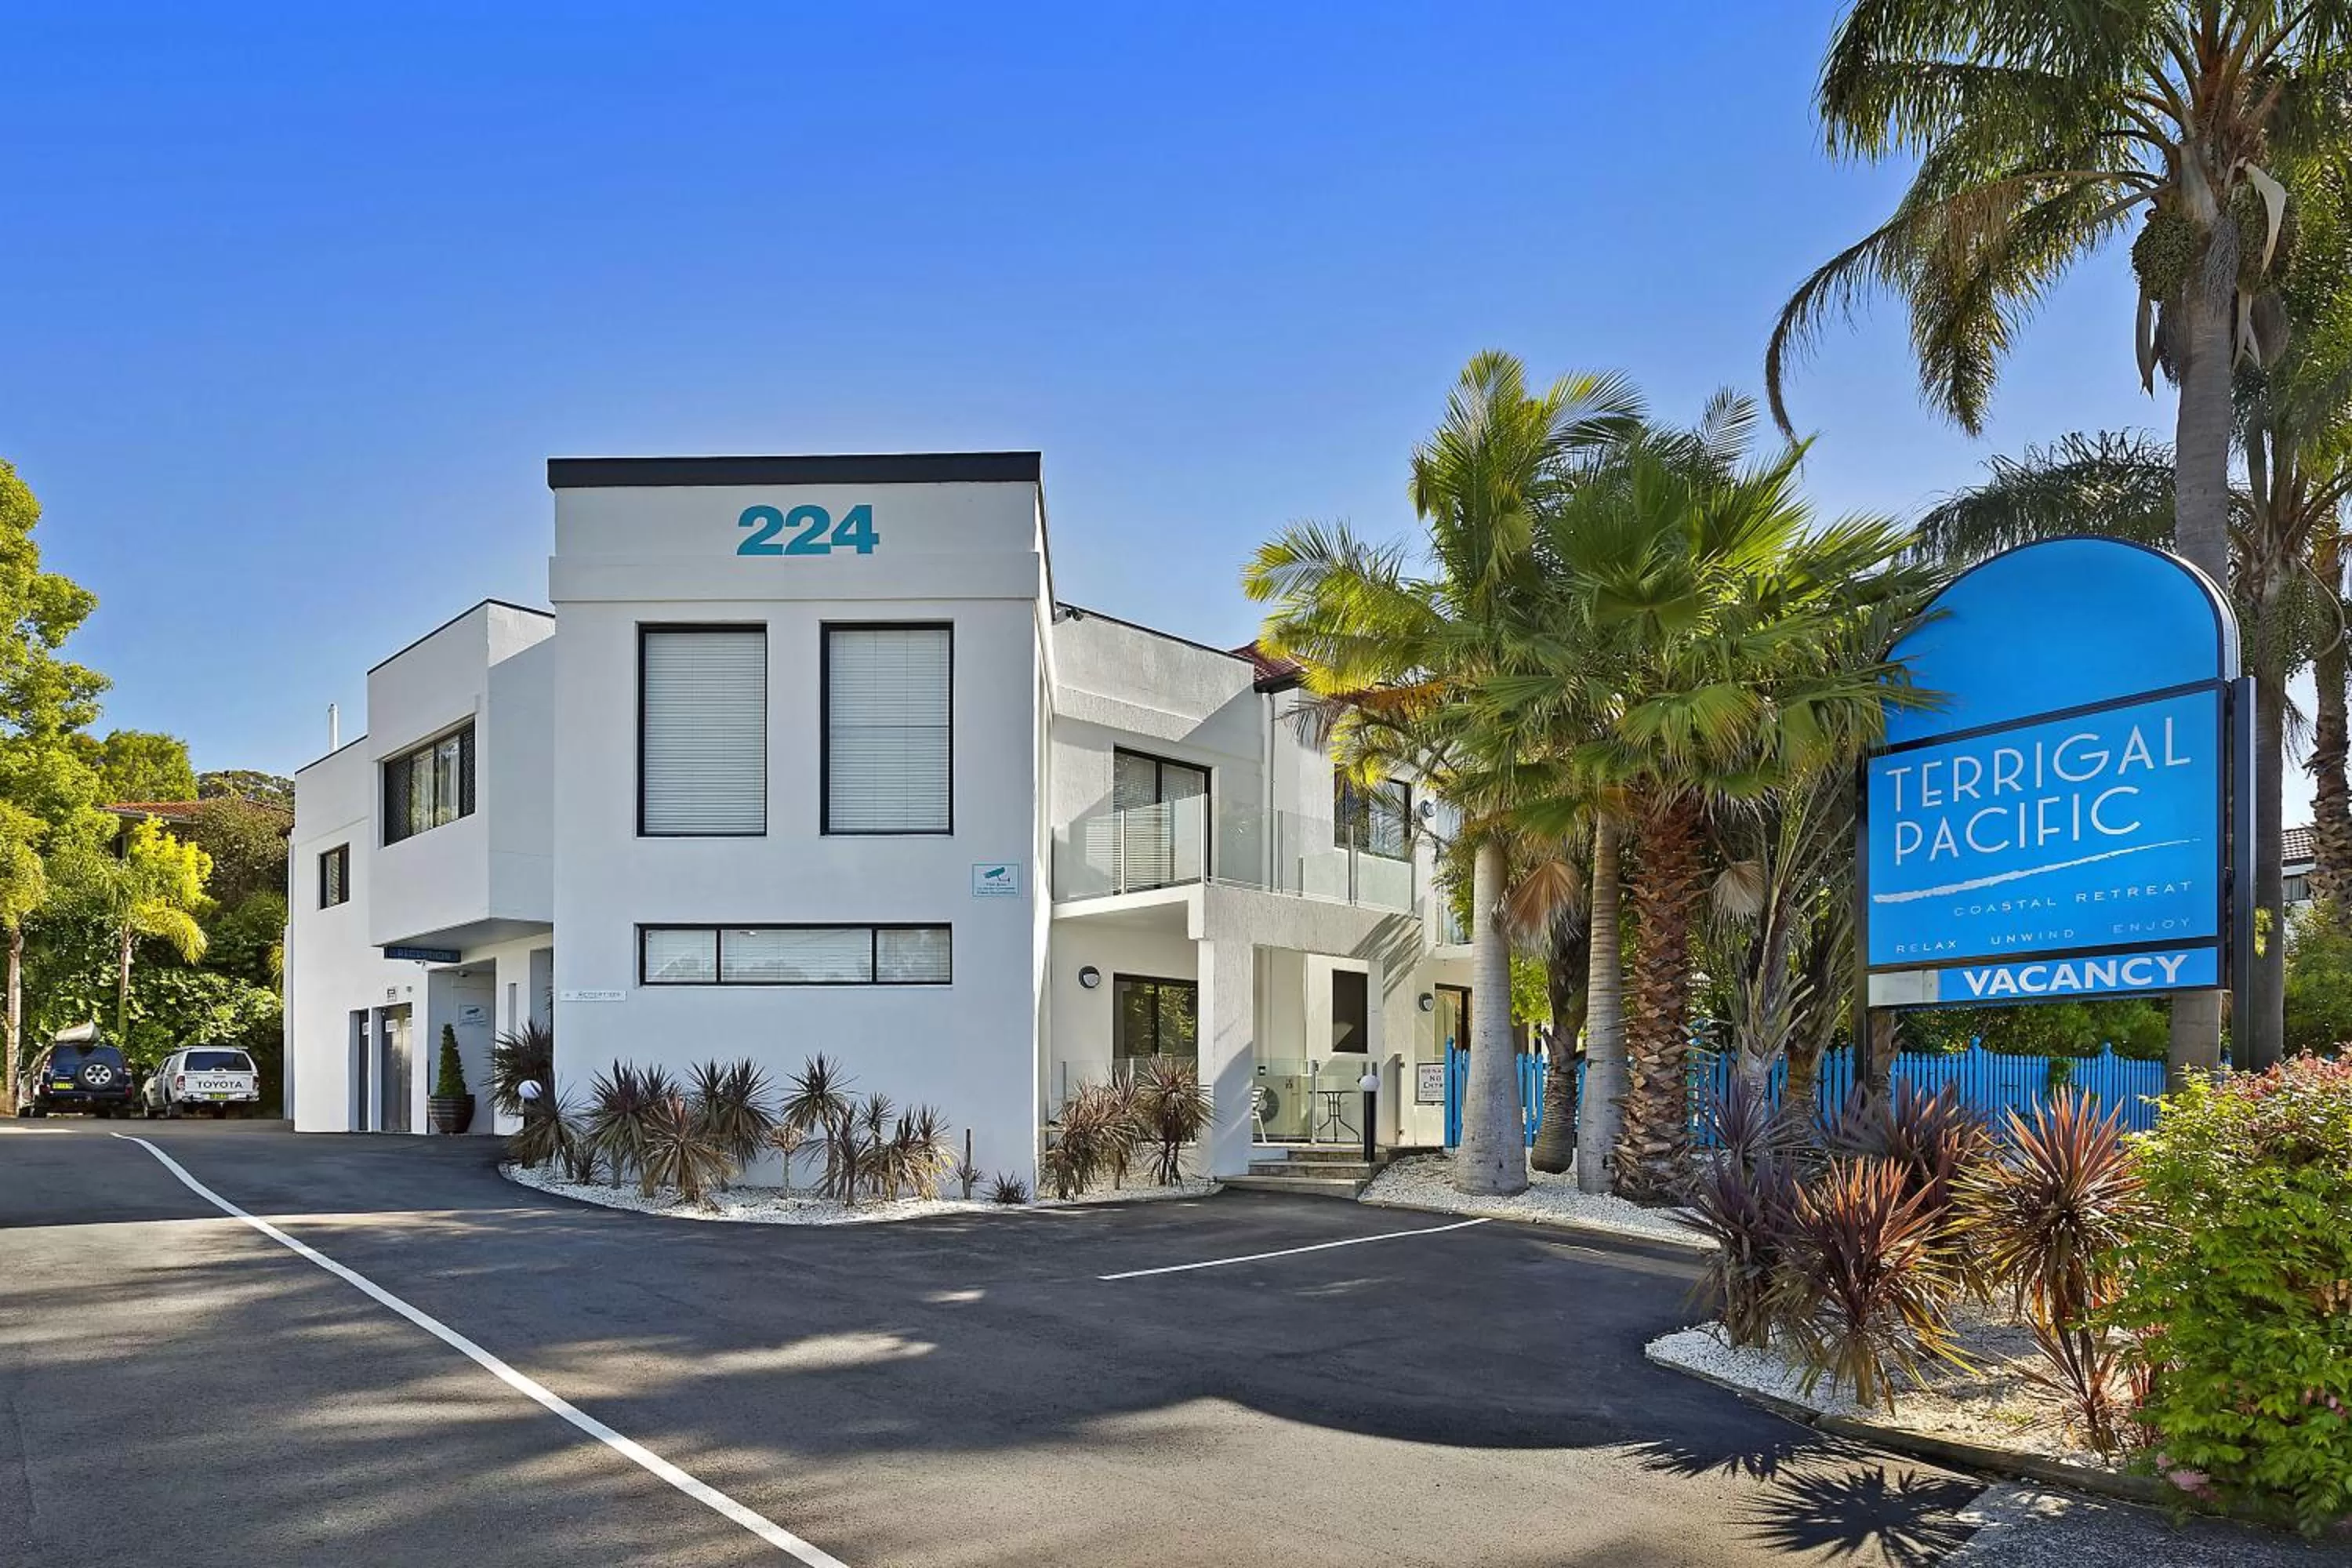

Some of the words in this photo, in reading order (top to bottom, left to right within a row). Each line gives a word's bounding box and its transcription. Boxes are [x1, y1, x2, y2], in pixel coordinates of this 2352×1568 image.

[737, 504, 880, 556] 224
[1886, 717, 2191, 812] TERRIGAL
[1896, 786, 2142, 866] PACIFIC
[1953, 897, 2057, 916] COASTAL
[2075, 880, 2193, 903] RETREAT
[1896, 939, 1958, 954] RELAX
[1991, 928, 2075, 946] UNWIND
[2112, 917, 2190, 935] ENJOY
[1963, 953, 2189, 996] VACANCY
